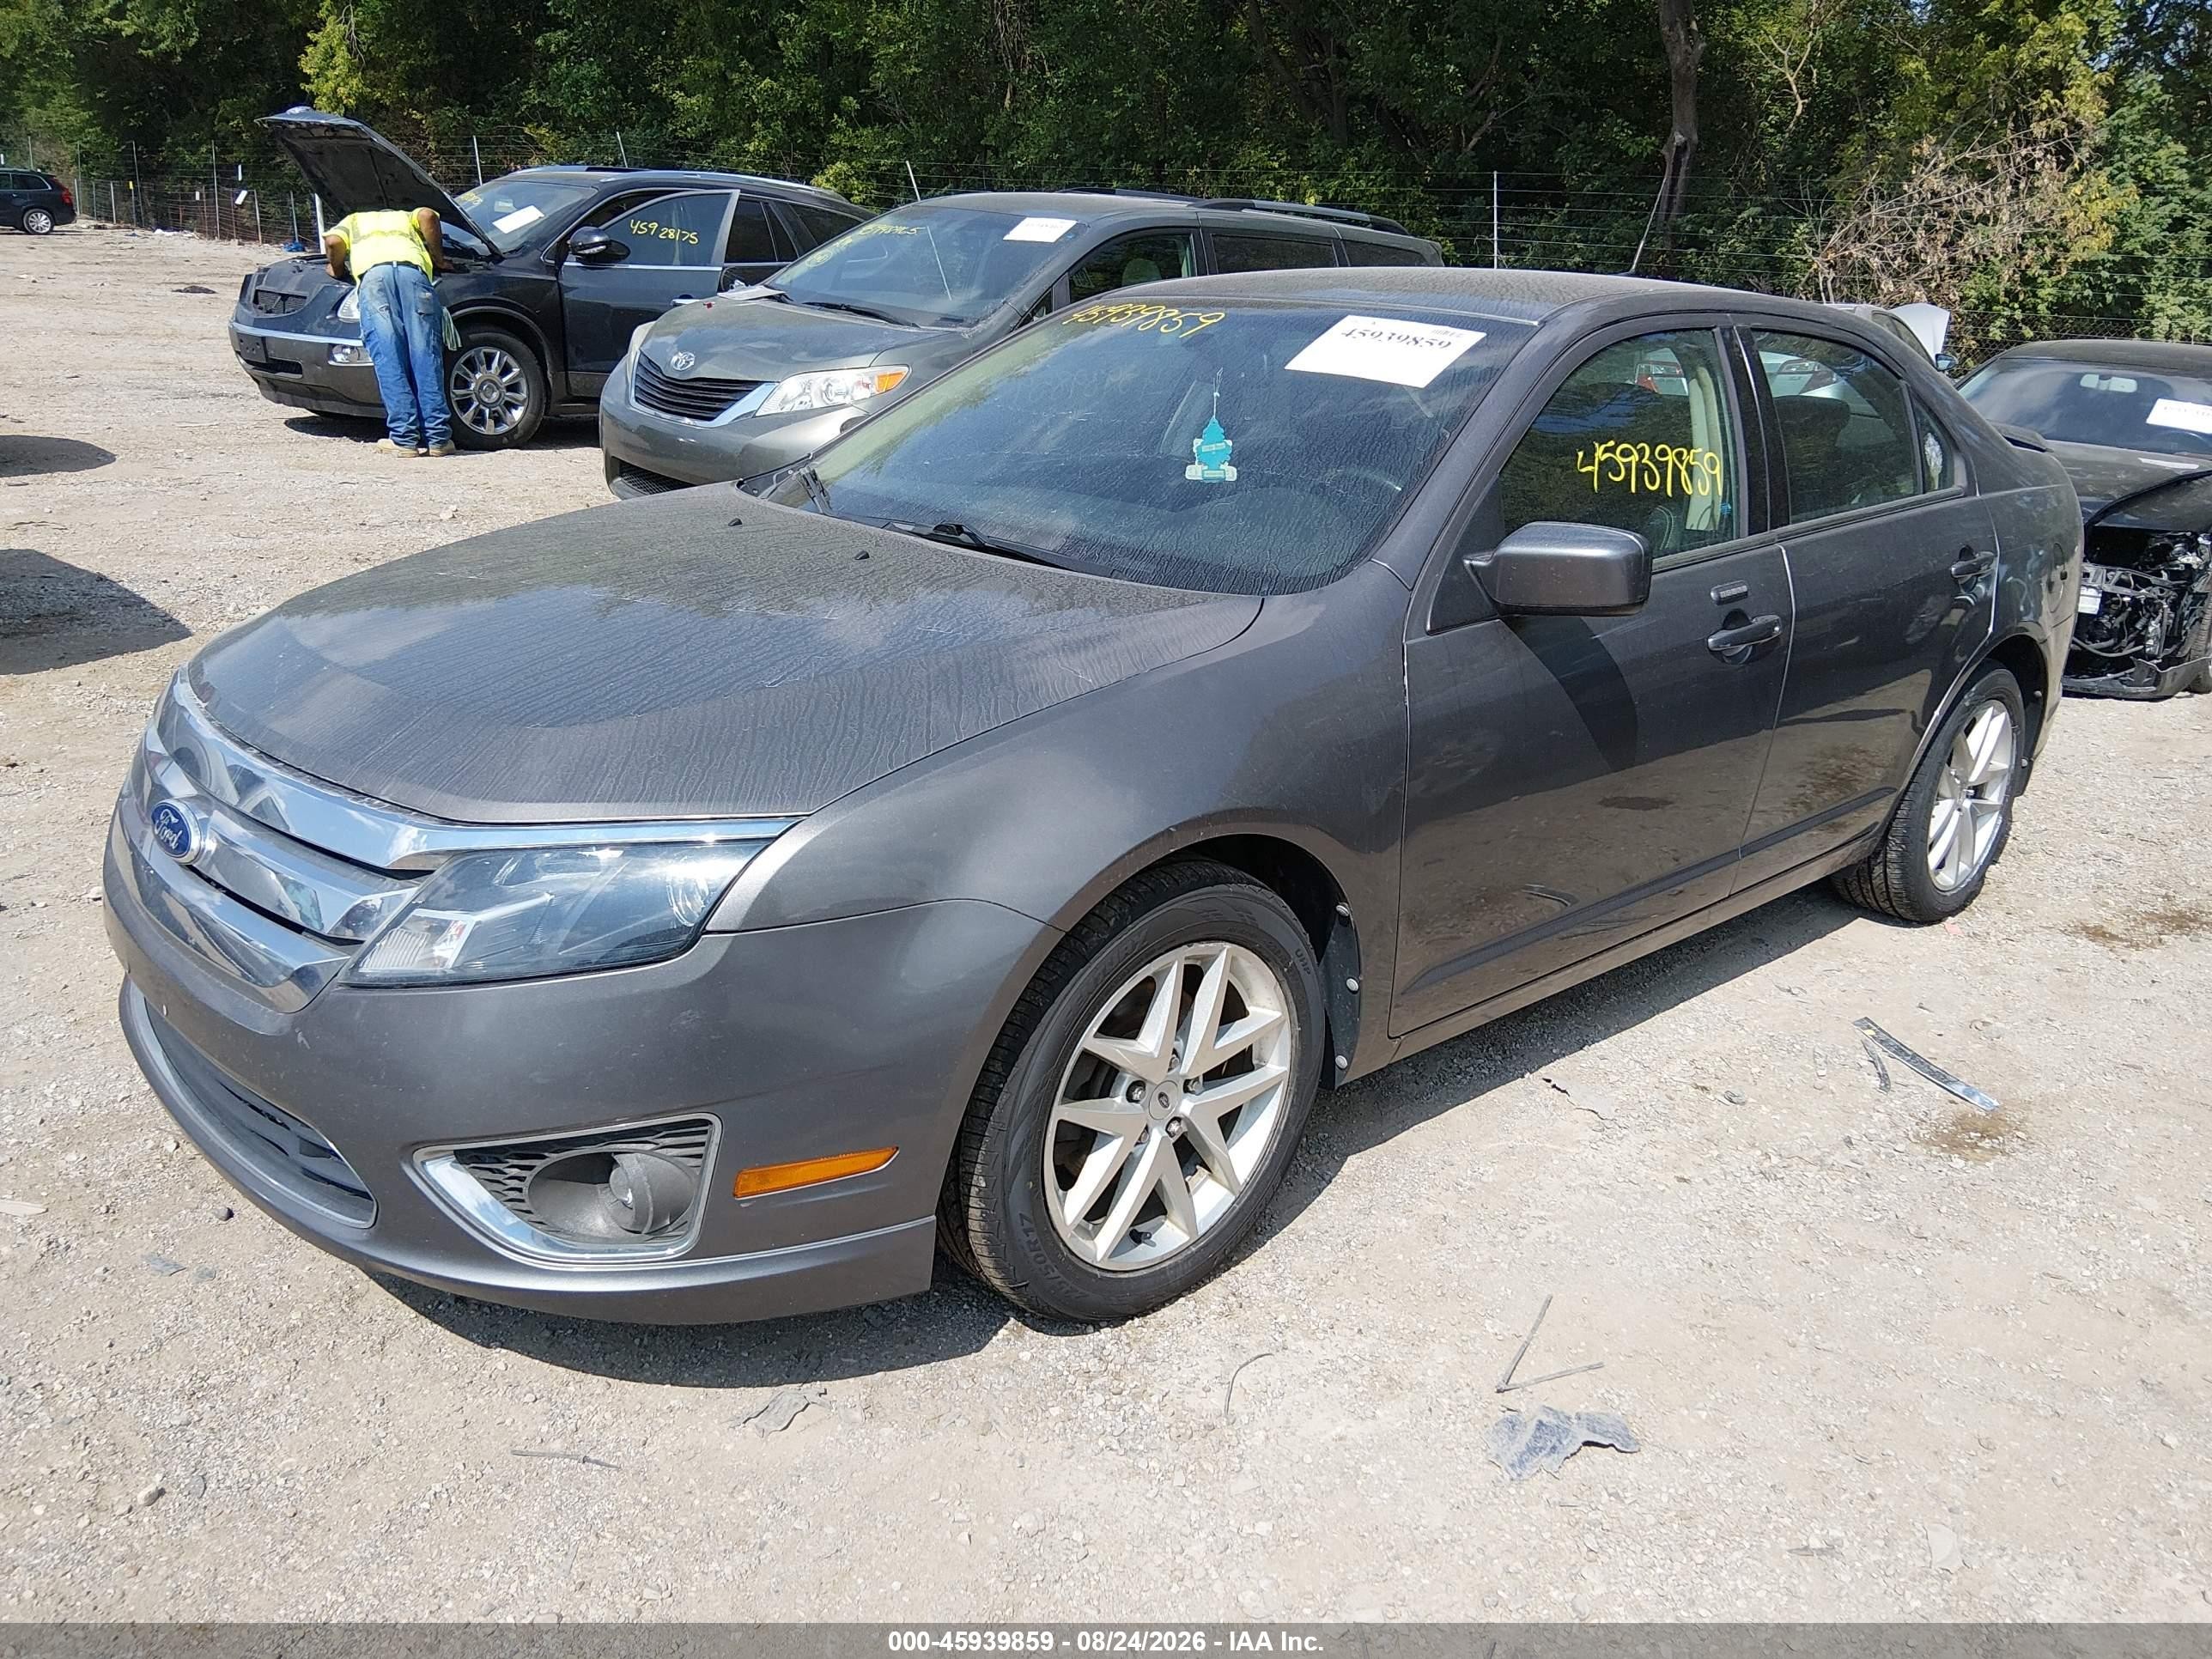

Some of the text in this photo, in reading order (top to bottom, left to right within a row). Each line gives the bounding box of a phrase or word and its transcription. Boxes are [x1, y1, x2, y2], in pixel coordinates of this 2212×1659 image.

[1340, 327, 1452, 349] 45939859
[1576, 440, 1723, 497] 45939859
[155, 809, 183, 849] Ford
